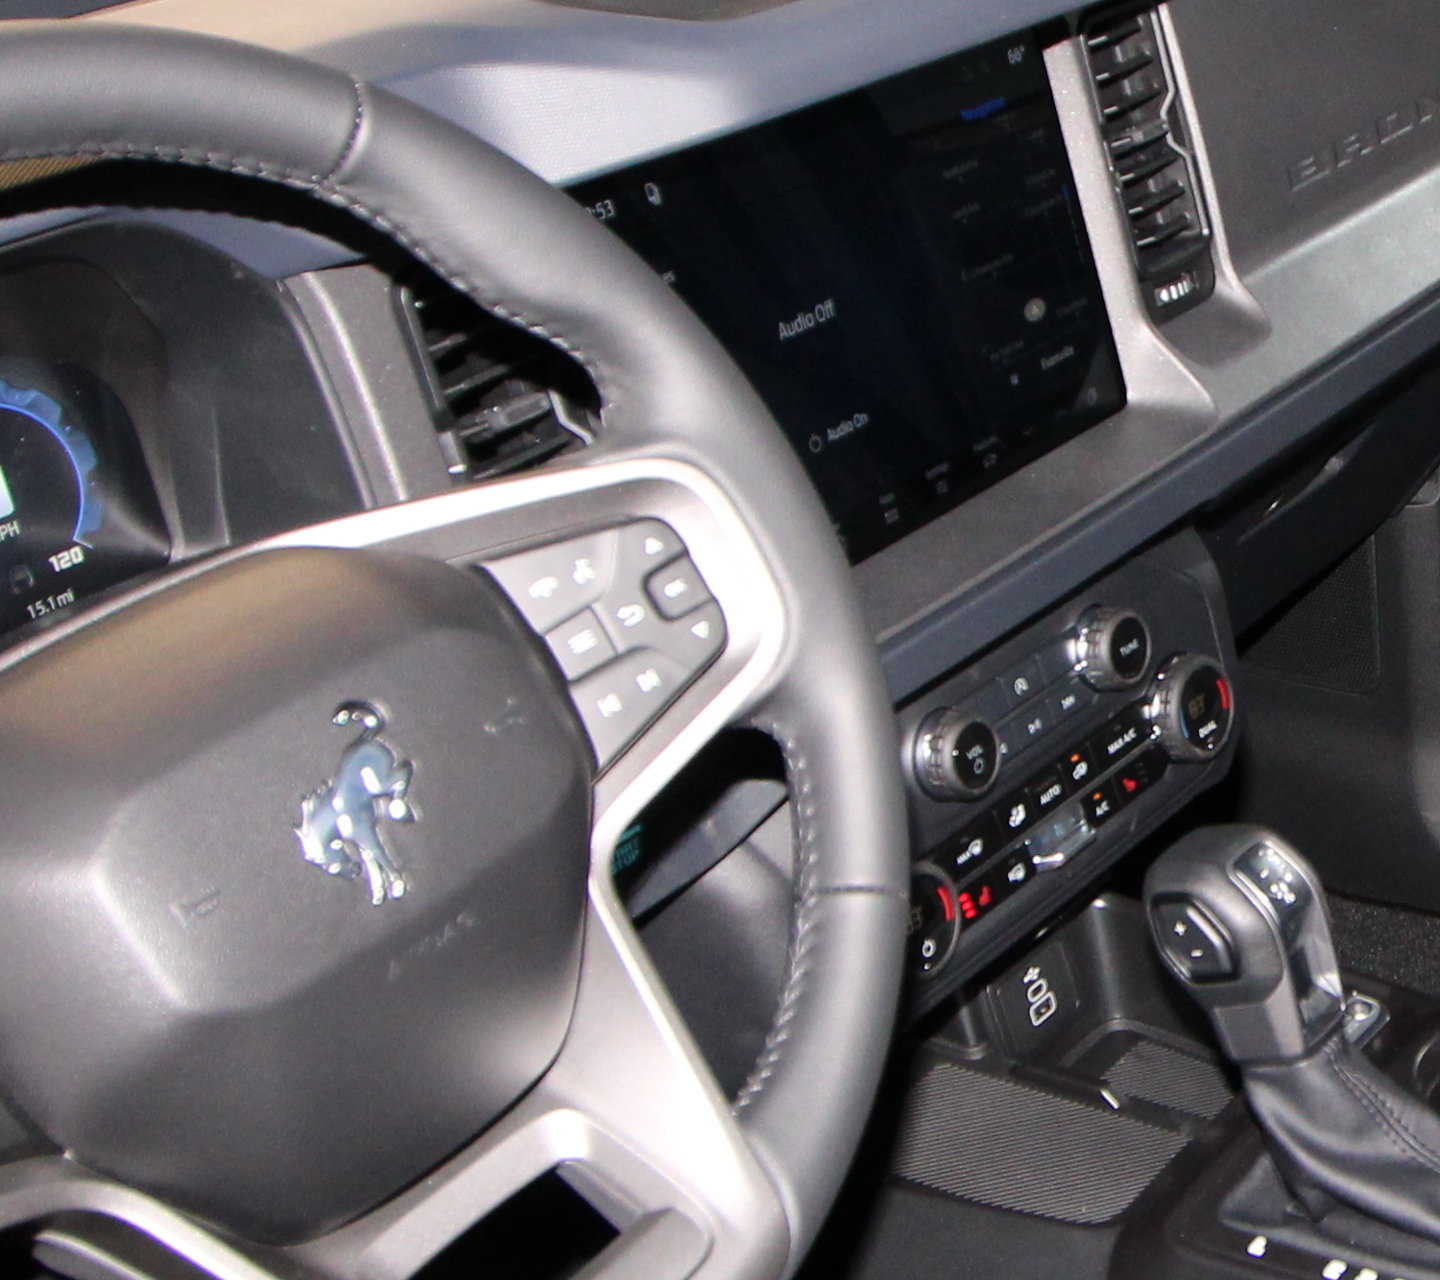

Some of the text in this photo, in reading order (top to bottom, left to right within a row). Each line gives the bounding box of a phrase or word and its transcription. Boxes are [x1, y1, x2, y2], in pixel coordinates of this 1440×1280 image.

[777, 297, 837, 341] Audio Off
[826, 411, 869, 443] Audio On
[48, 545, 85, 572] 120
[26, 587, 76, 619] 15.1 mi
[1040, 783, 1063, 806] AUTO
